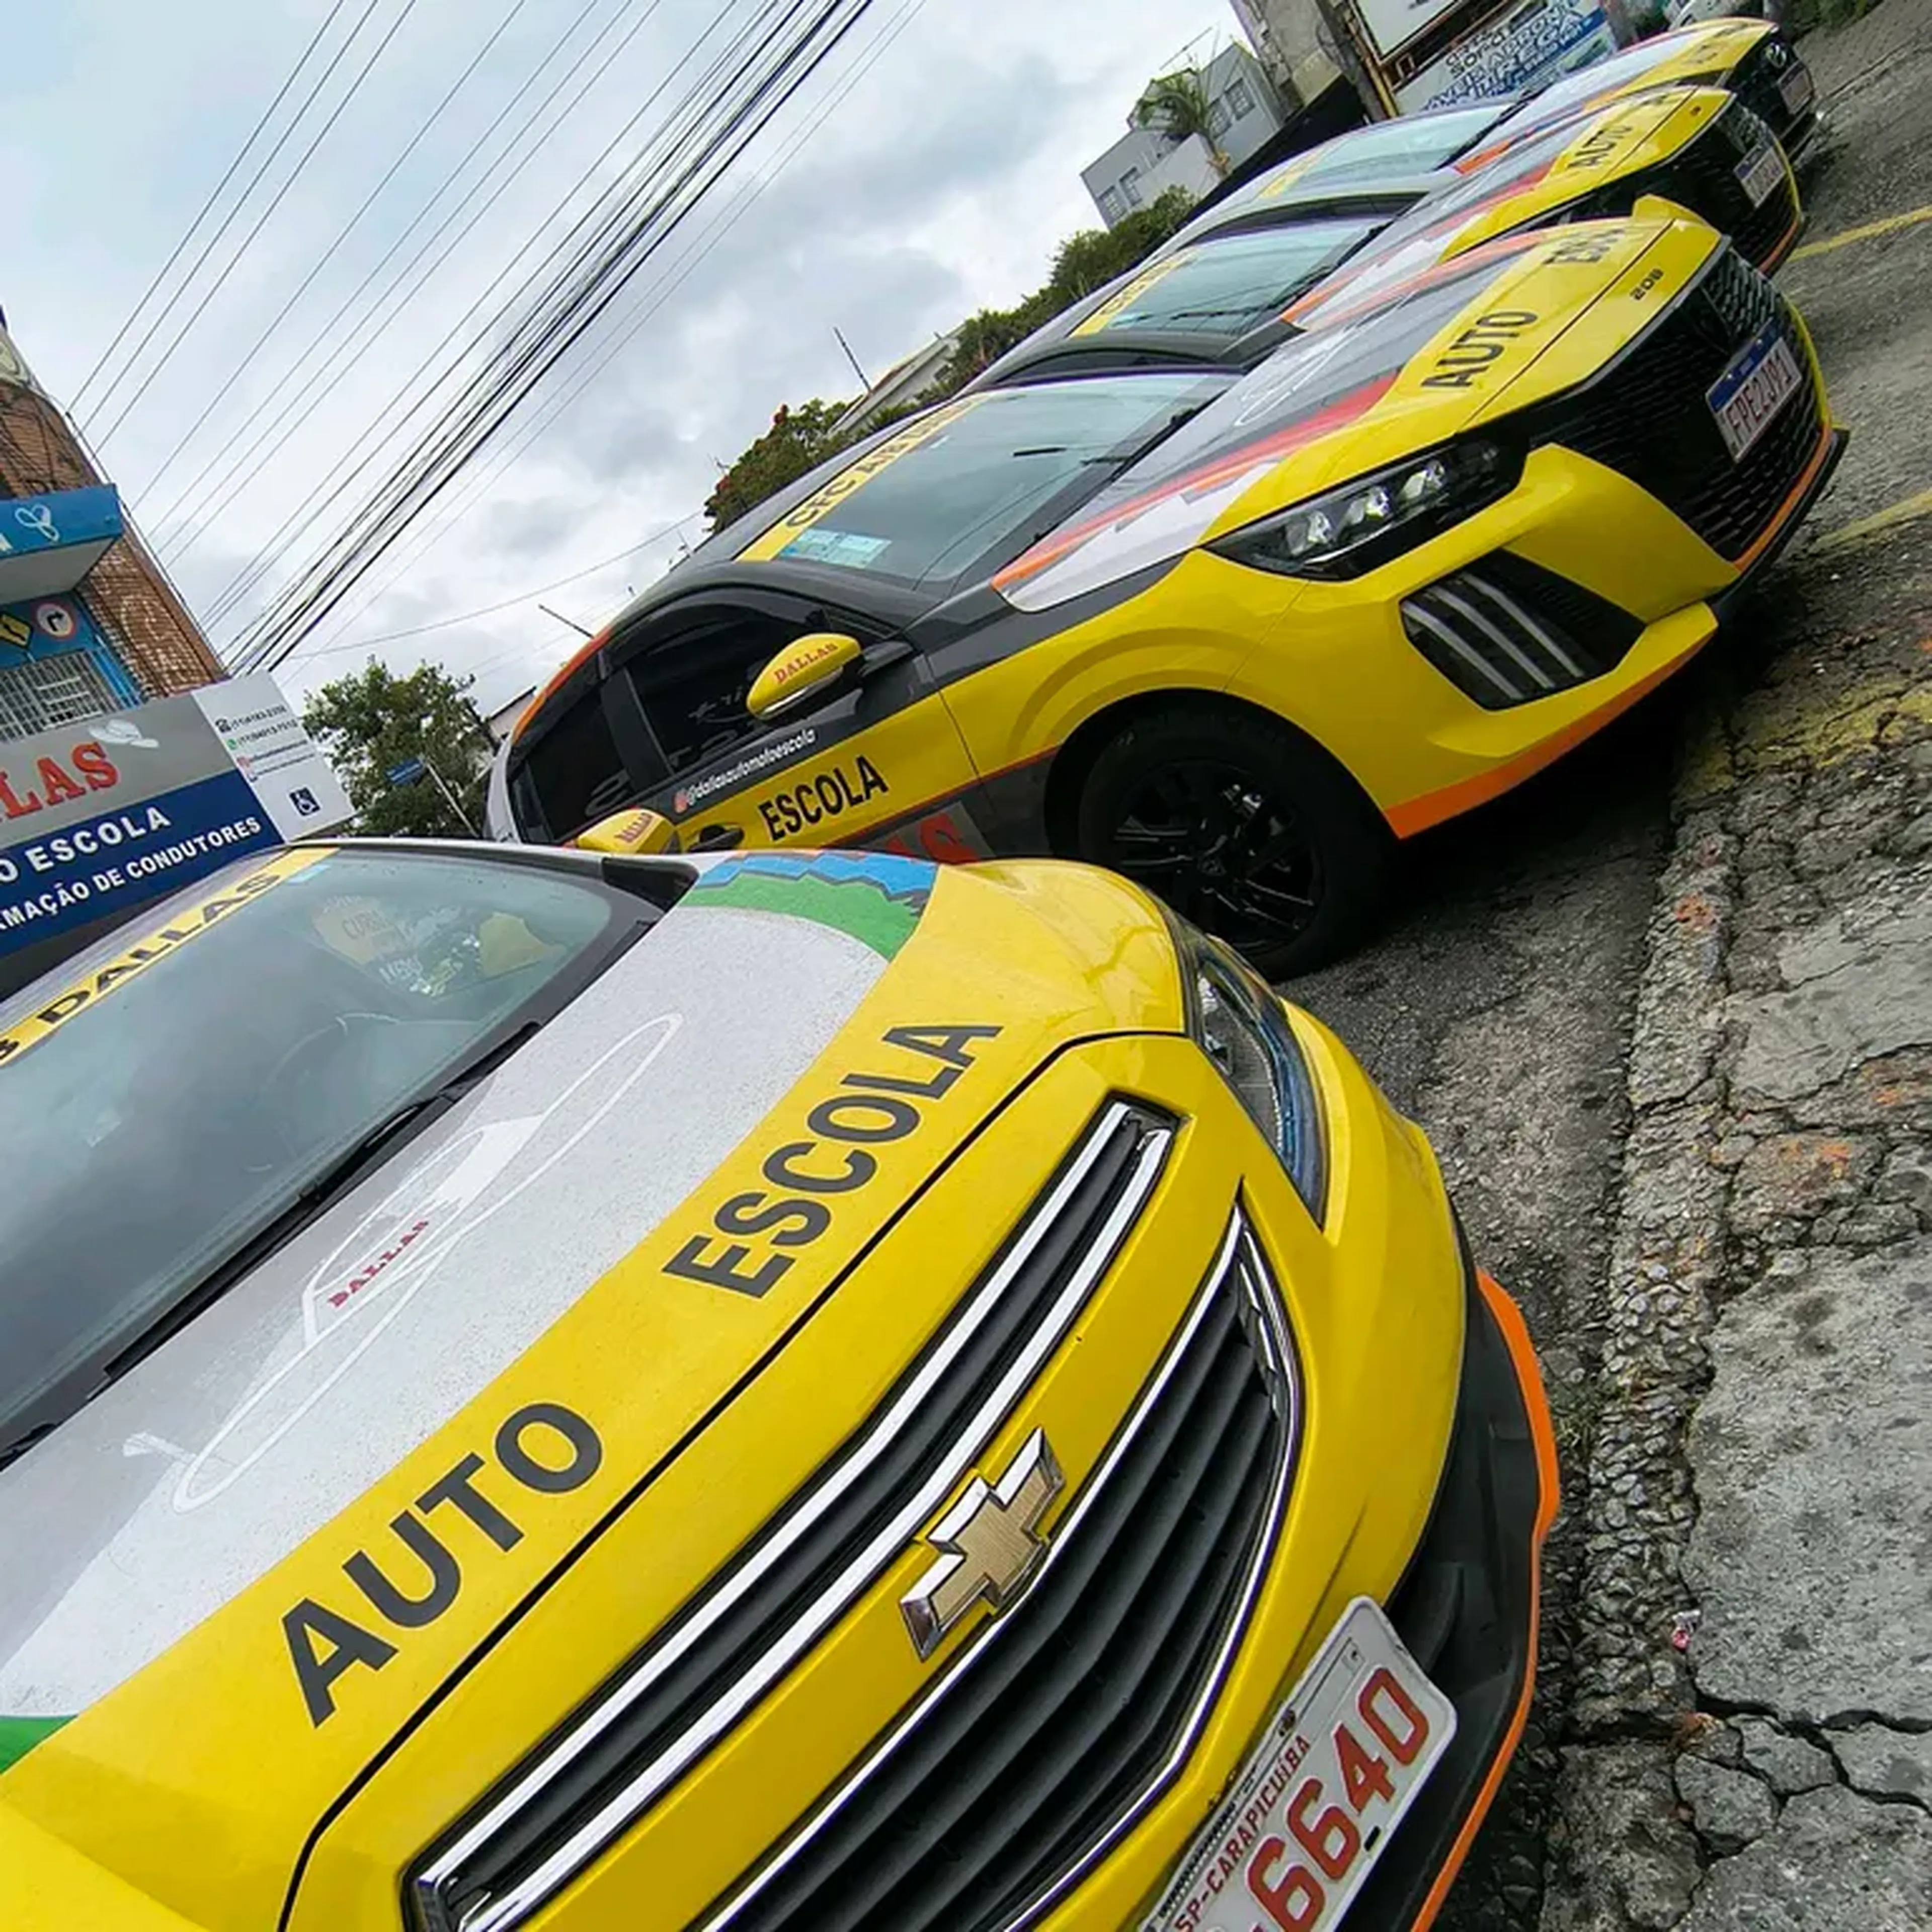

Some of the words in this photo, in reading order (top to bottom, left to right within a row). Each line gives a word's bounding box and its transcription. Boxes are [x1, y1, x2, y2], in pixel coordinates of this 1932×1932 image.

[1629, 269, 1664, 300] 208
[1421, 310, 1539, 391] AUTO
[773, 642, 838, 684] DALLAS
[25, 807, 171, 871] ESCOLA
[758, 755, 889, 842] ESCOLA
[92, 868, 125, 892] DE
[126, 817, 261, 878] CONDUTORES
[36, 872, 281, 1024] DALLAS
[328, 1221, 429, 1309] DALLAS
[280, 1402, 603, 1729] AUTO
[662, 1020, 1004, 1299] ESCOLA
